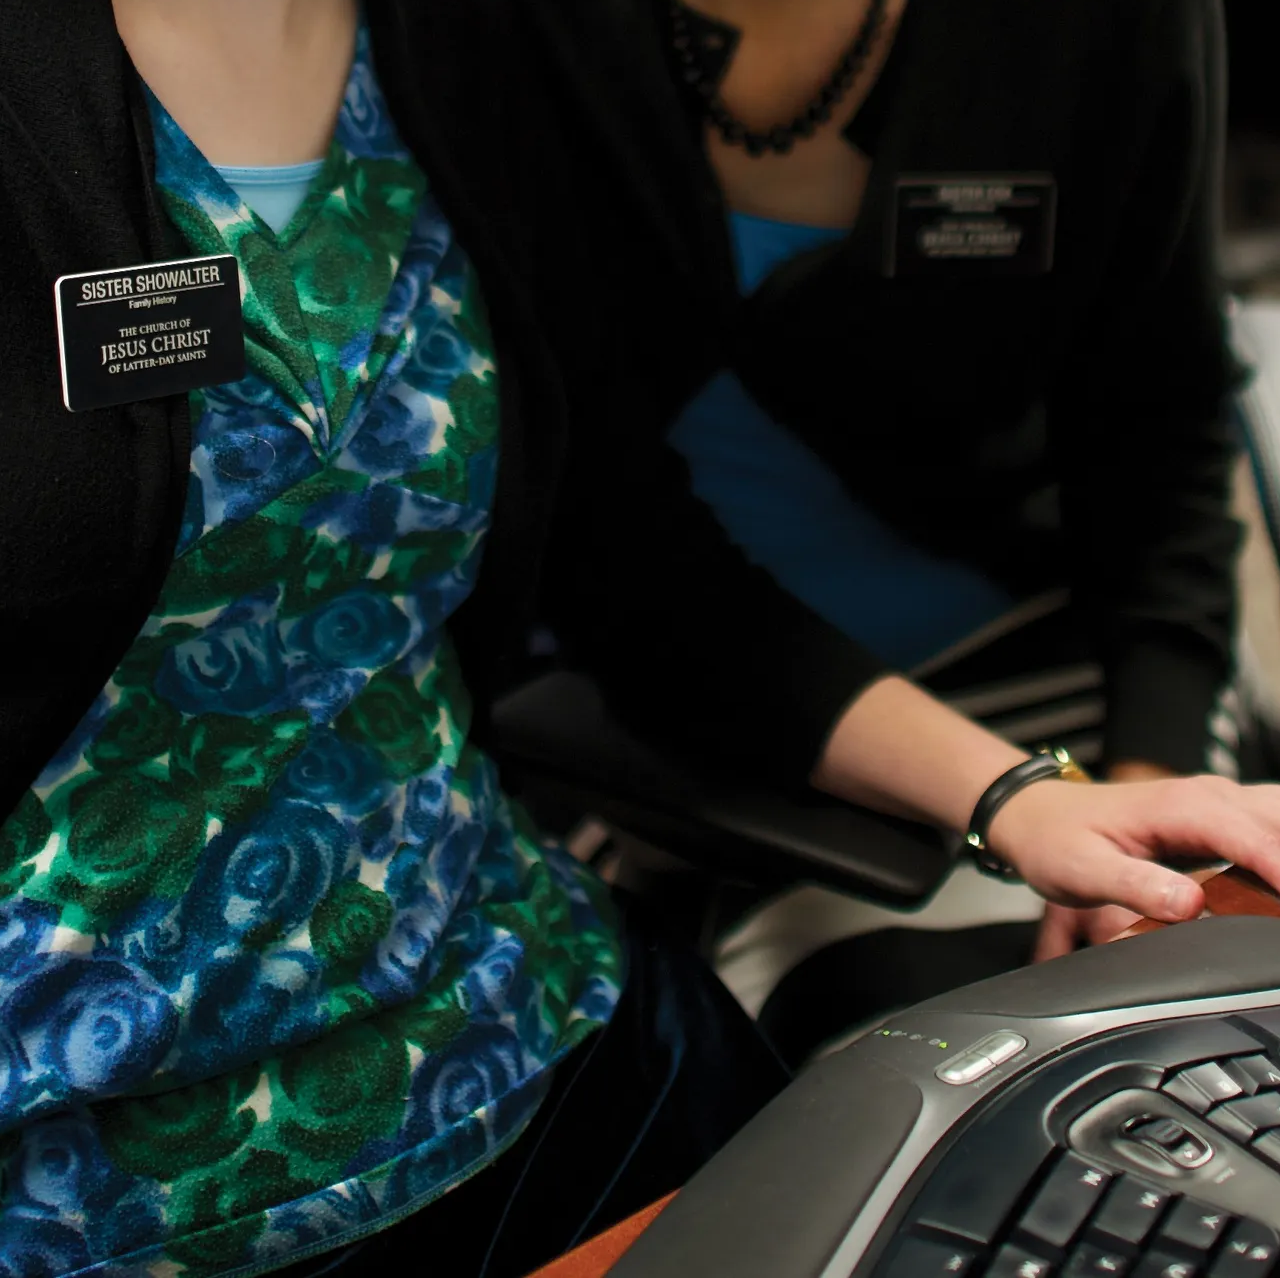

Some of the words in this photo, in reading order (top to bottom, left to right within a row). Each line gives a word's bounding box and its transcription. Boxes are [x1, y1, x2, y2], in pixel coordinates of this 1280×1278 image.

[81, 277, 133, 301] SISTER
[136, 265, 220, 293] SHOWALTER
[128, 298, 152, 309] Family
[153, 295, 177, 307] History
[118, 326, 137, 338] THE
[139, 321, 177, 335] CHURCH
[179, 318, 191, 328] OF
[101, 339, 147, 366] JESUS
[151, 329, 211, 353] CHRIST
[108, 363, 121, 374] OF
[123, 354, 176, 372] LATTER-DAY
[177, 349, 207, 363] SAINTS
